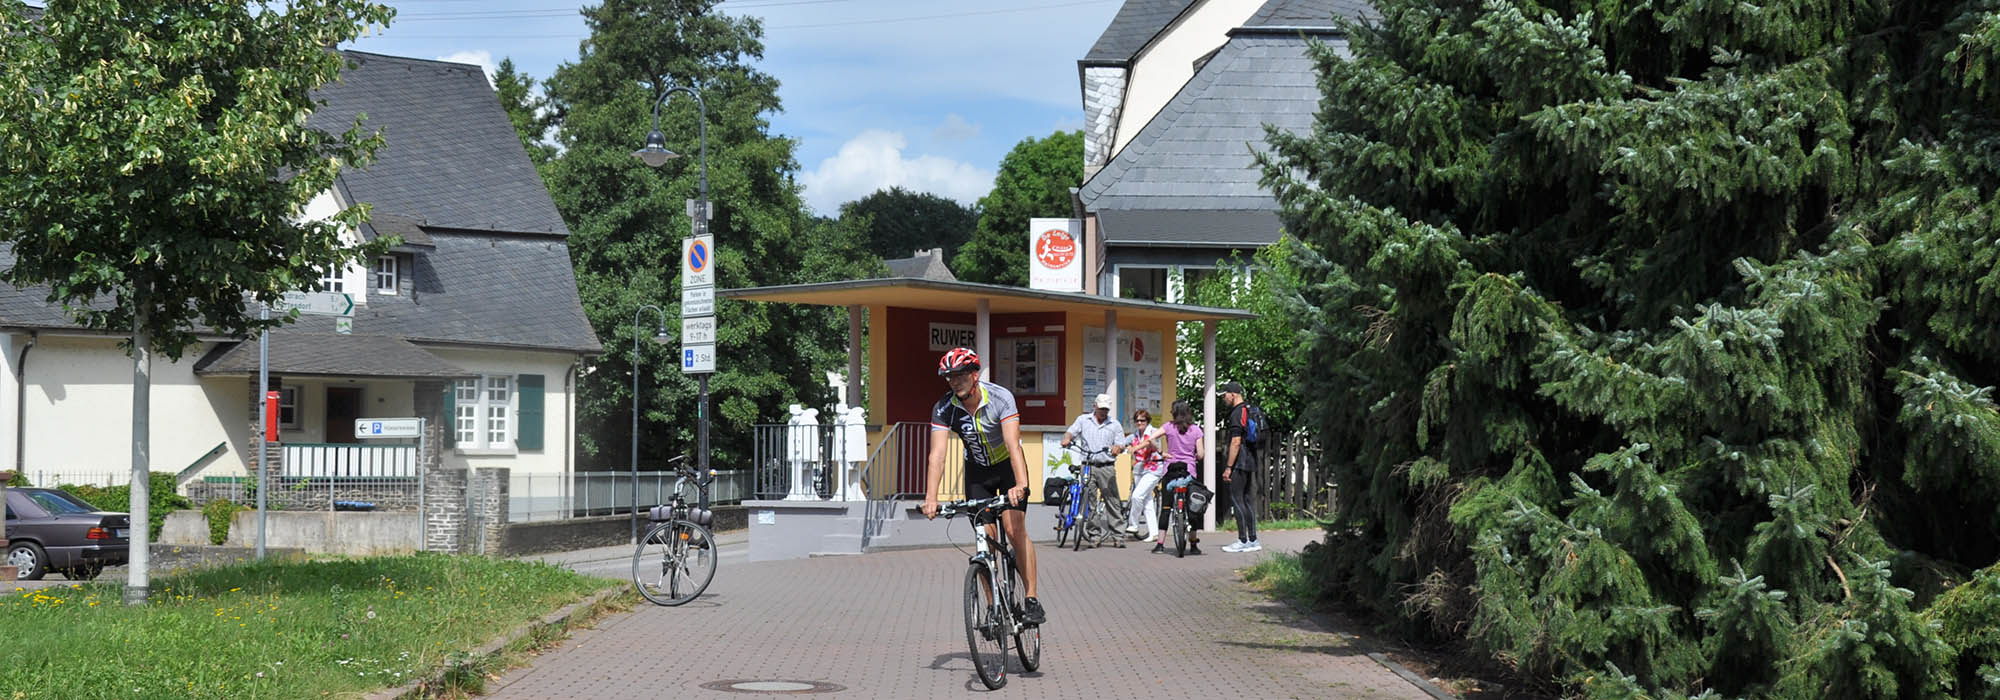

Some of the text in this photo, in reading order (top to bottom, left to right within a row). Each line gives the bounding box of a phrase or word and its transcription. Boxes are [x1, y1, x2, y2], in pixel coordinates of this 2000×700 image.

[690, 274, 706, 284] ZONE
[686, 321, 712, 330] werktags
[931, 328, 976, 346] RUWER
[695, 354, 700, 363] 2
[374, 423, 381, 433] P
